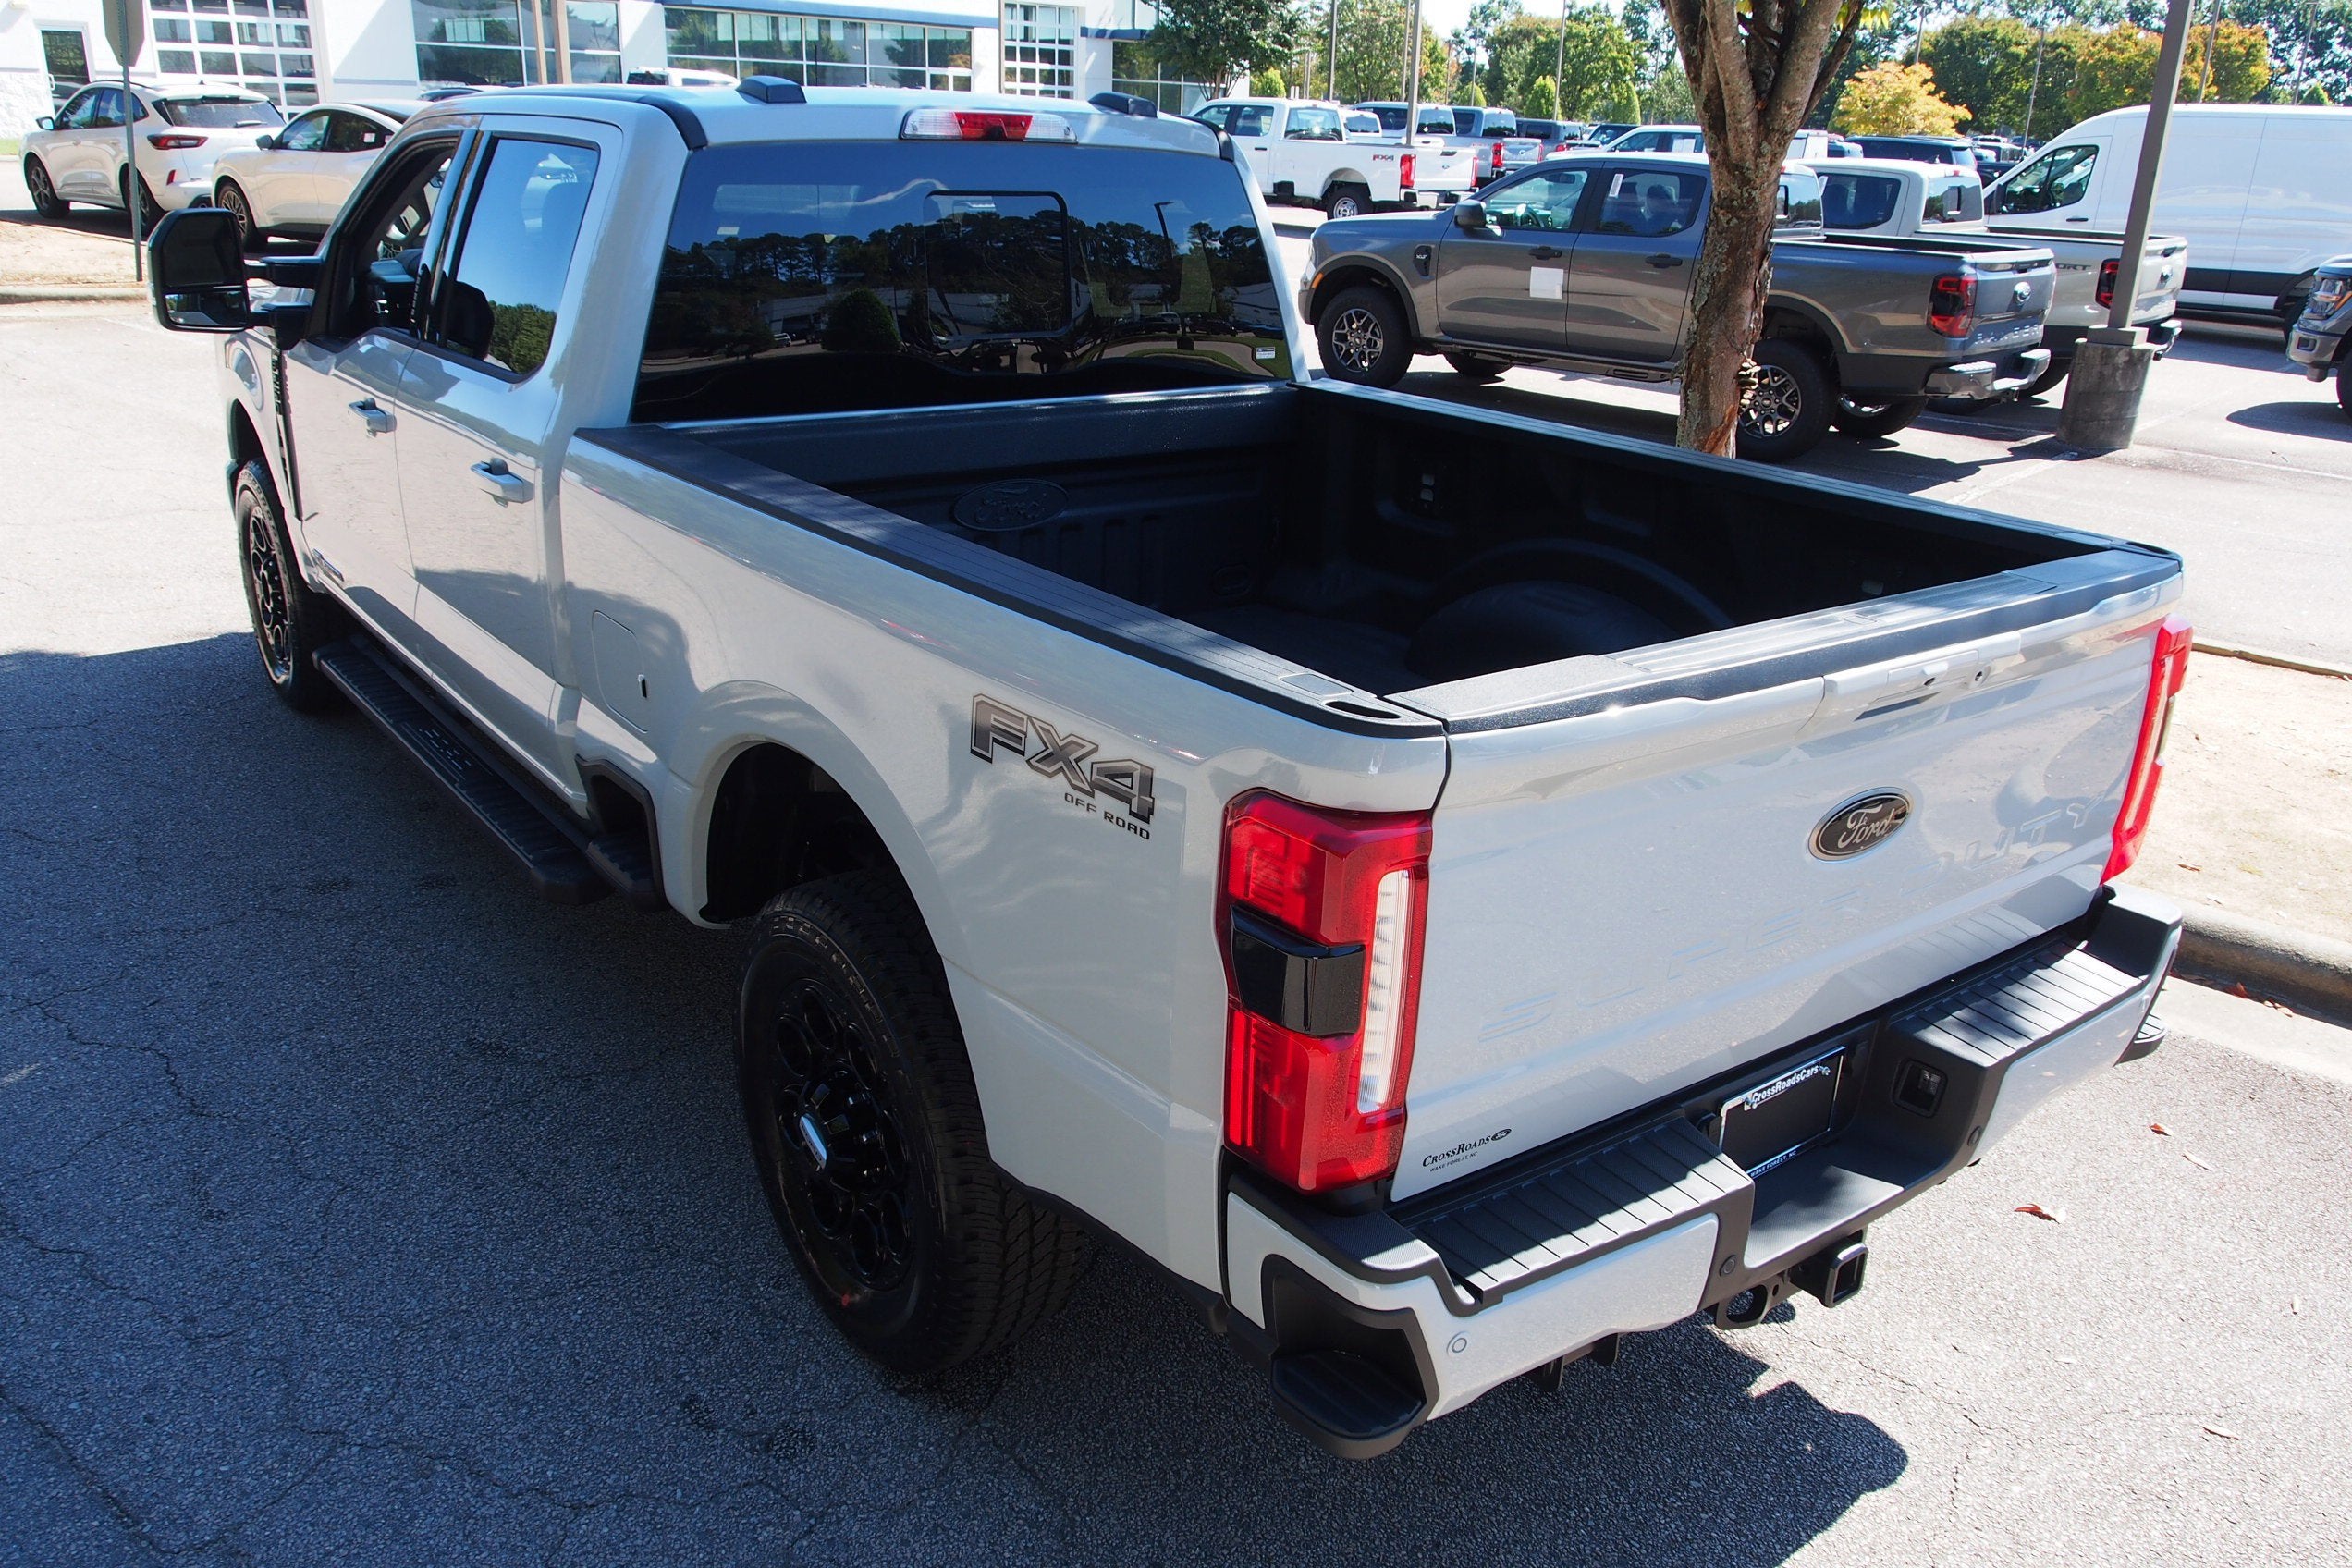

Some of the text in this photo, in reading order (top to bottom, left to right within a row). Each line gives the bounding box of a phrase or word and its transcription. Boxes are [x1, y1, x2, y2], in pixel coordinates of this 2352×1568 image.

[970, 692, 1155, 825] FX4
[1064, 791, 1150, 840] OFF ROAD
[1837, 803, 1896, 849] Ford
[1899, 791, 2107, 897] DUTY
[1429, 1161, 1446, 1173] WAKE
[1750, 1166, 1766, 1178] WAKE
